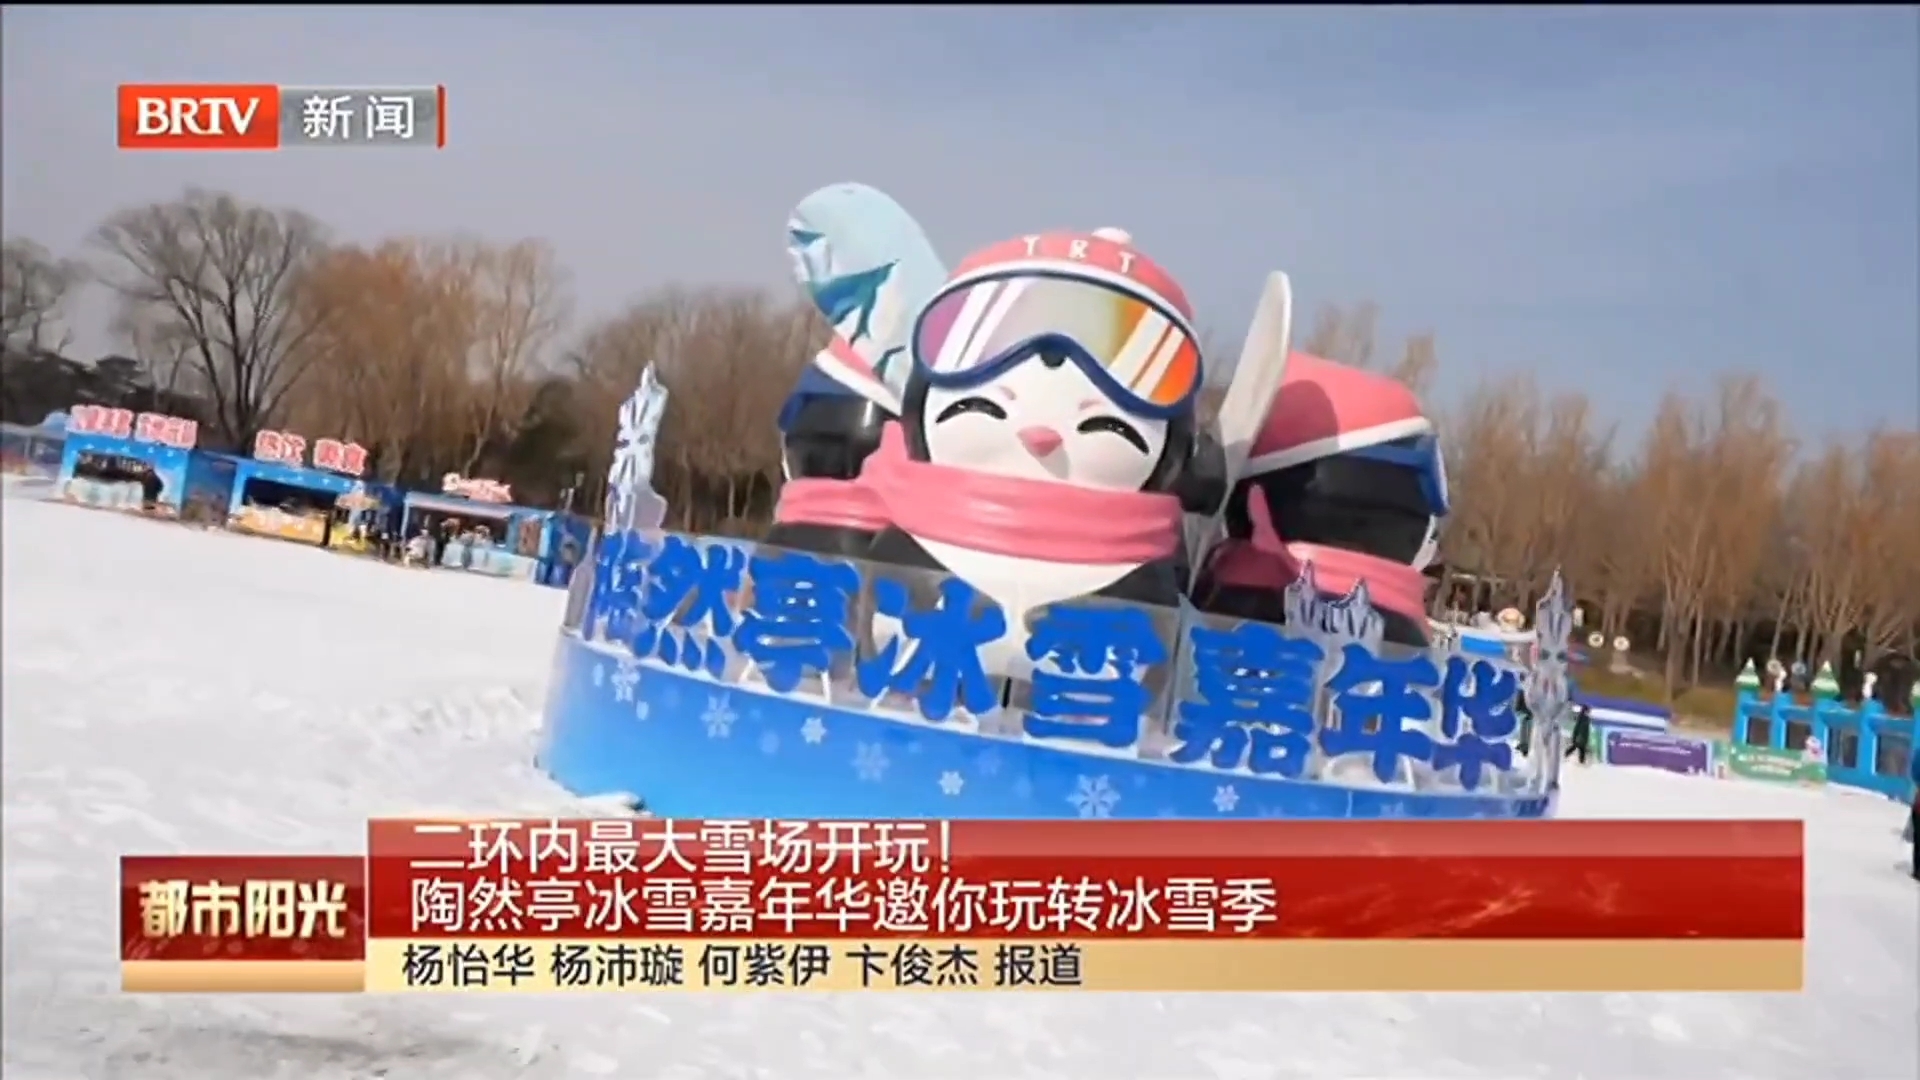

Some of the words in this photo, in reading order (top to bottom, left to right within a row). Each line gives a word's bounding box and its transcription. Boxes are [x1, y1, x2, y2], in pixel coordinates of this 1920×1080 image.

[1022, 234, 1136, 274] TRT
[584, 529, 1518, 792] 陶然亭冰雪嘉年华
